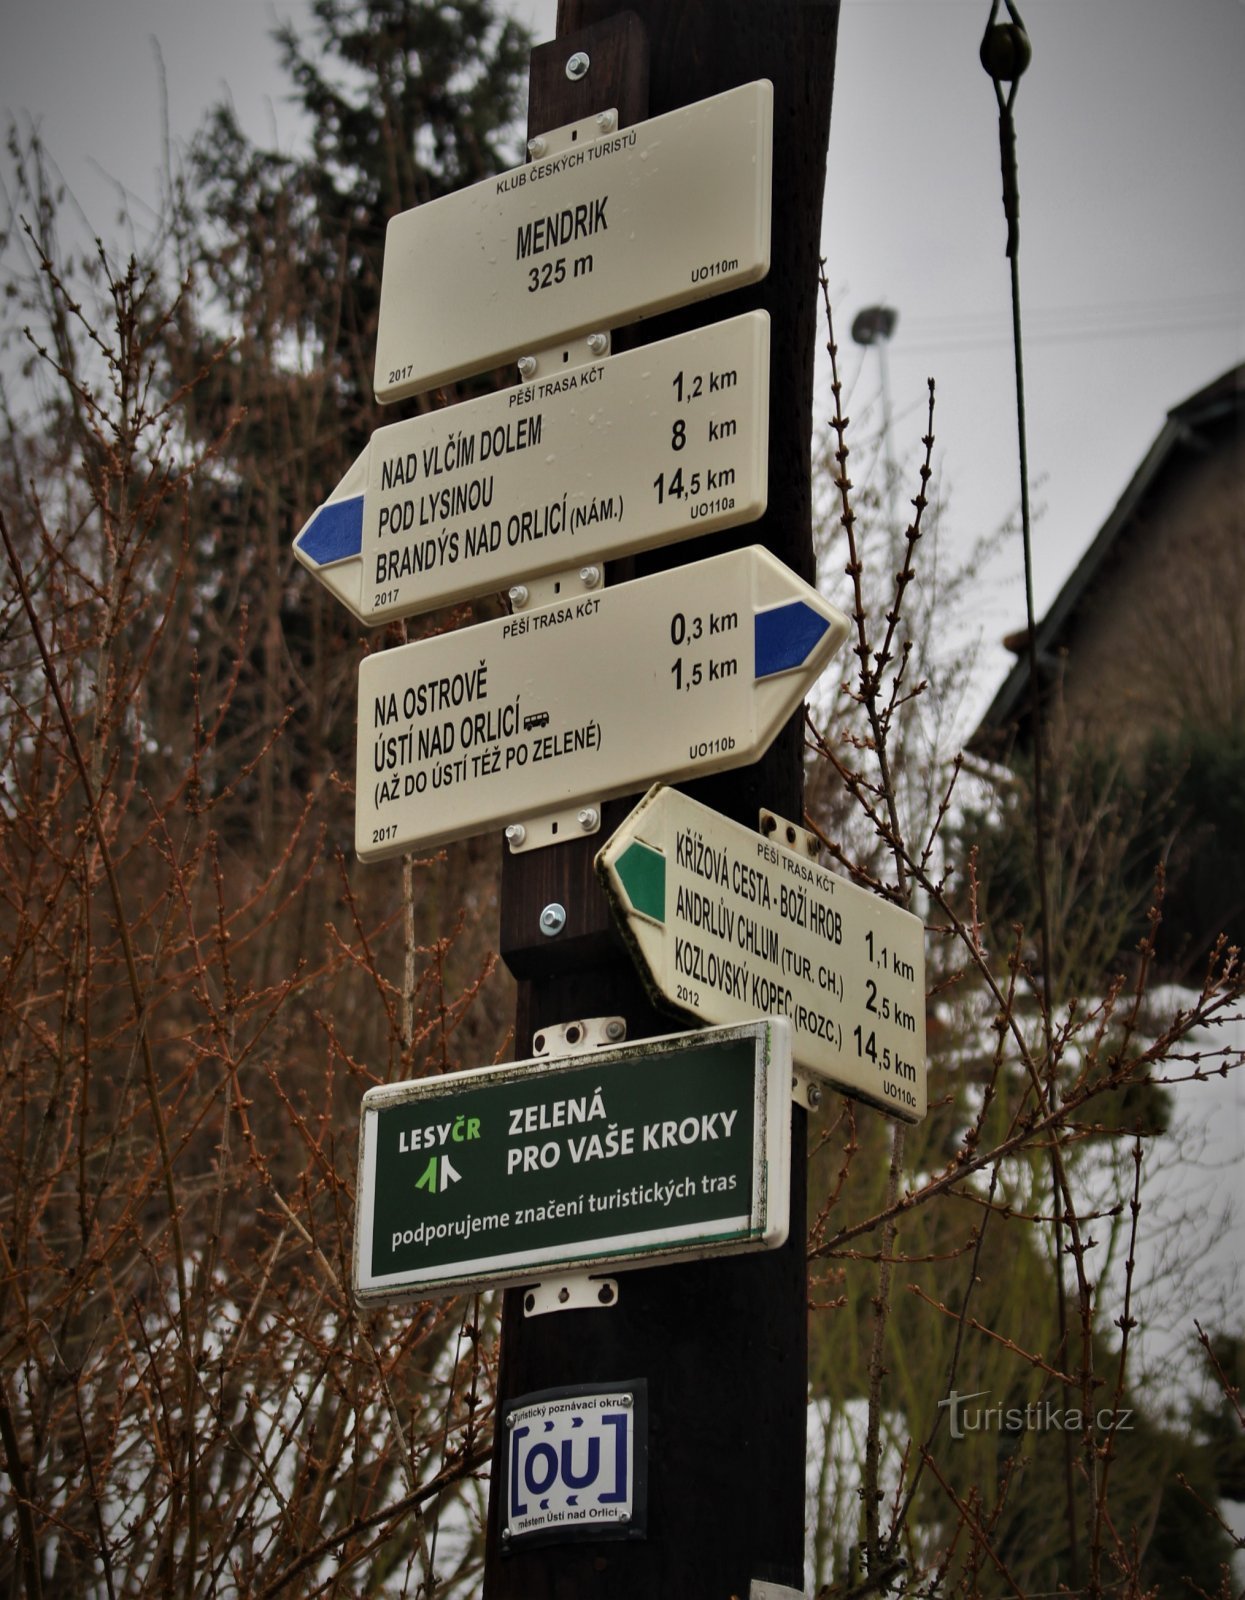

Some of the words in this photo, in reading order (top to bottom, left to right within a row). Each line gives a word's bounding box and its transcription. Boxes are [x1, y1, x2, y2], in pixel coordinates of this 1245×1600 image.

[496, 173, 527, 195] KLUB
[530, 151, 584, 182] ČESKÝCH
[588, 130, 637, 163] TURISTŮ
[516, 195, 609, 260] MENDRIK
[528, 258, 566, 292] 325
[574, 254, 594, 277] m
[691, 258, 738, 283] UO110m
[389, 365, 413, 383] 2017
[509, 383, 536, 408] PĚŠÍ
[538, 376, 577, 400] TRASA
[580, 367, 605, 390] KČT
[381, 453, 417, 491] NAD
[423, 430, 475, 481] VLČÍM
[480, 414, 542, 461] DOLEM
[672, 371, 703, 402] 1,2
[709, 368, 737, 392] km
[379, 503, 414, 537] POD
[420, 476, 494, 527] LYSINOU
[671, 419, 686, 451] 8
[709, 418, 737, 441] km
[375, 529, 459, 584] BRANDÝS
[464, 522, 501, 559] NAD
[507, 492, 567, 547] ORLICÍ
[570, 495, 624, 535] (NÁM.)
[653, 467, 701, 504] 14,5
[707, 467, 735, 490] km
[690, 497, 735, 520] UO110a
[374, 589, 399, 607] 2017
[503, 617, 530, 639] PĚŠÍ
[533, 608, 573, 631] TRASA
[576, 599, 600, 621] KČT
[374, 694, 398, 727] NA
[403, 659, 487, 720] OSTROVĚ
[670, 612, 703, 646] 0,3
[708, 609, 738, 634] km
[374, 726, 414, 773] ÚSTÍ
[418, 721, 454, 759] NAD
[460, 695, 520, 747] ORLICÍ
[670, 656, 702, 690] 1,5
[708, 656, 738, 681] km
[375, 775, 400, 810] (AŽ
[405, 762, 427, 793] DO
[432, 753, 468, 789] ÚSTÍ
[472, 742, 501, 779] TÉŽ
[505, 741, 527, 767] PO
[532, 722, 601, 762] ZELENÉ)
[689, 737, 735, 760] UO110b
[372, 825, 398, 844] 2017
[757, 842, 779, 866] PĚŠÍ
[782, 855, 814, 885] TRASA
[816, 872, 835, 895] KČT
[676, 827, 729, 890] KŘÍŽOVÁ
[733, 861, 770, 910] CESTA
[781, 883, 807, 929] BOŽÍ
[810, 907, 842, 945] HROB
[865, 930, 889, 970] 1,1
[894, 952, 915, 982] km
[676, 885, 734, 943] ANDRLŮV
[737, 918, 779, 966] CHLUM
[781, 947, 815, 985] (TUR.
[818, 964, 844, 1002] CH.)
[865, 979, 890, 1019] 2,5
[894, 1001, 916, 1032] km
[675, 936, 749, 1002] KOZLOVSKÝ
[794, 1003, 842, 1051] (ROZC.)
[853, 1025, 891, 1071] 14,5
[895, 1051, 916, 1082] km
[676, 985, 700, 1007] 2012
[508, 1087, 607, 1135] ZELENÁ
[507, 1141, 560, 1175] PRO
[568, 1123, 634, 1164] VAŠE
[643, 1109, 738, 1150] KROKY
[392, 1210, 510, 1251] podporujeme
[515, 1194, 584, 1226] značení
[588, 1175, 696, 1211] turistických
[701, 1172, 737, 1192] tras
[549, 1399, 597, 1414] poznávací
[518, 1516, 545, 1529] městem
[547, 1510, 565, 1522] Ústí
[567, 1509, 586, 1519] nad
[589, 1507, 618, 1518] Orlicí
